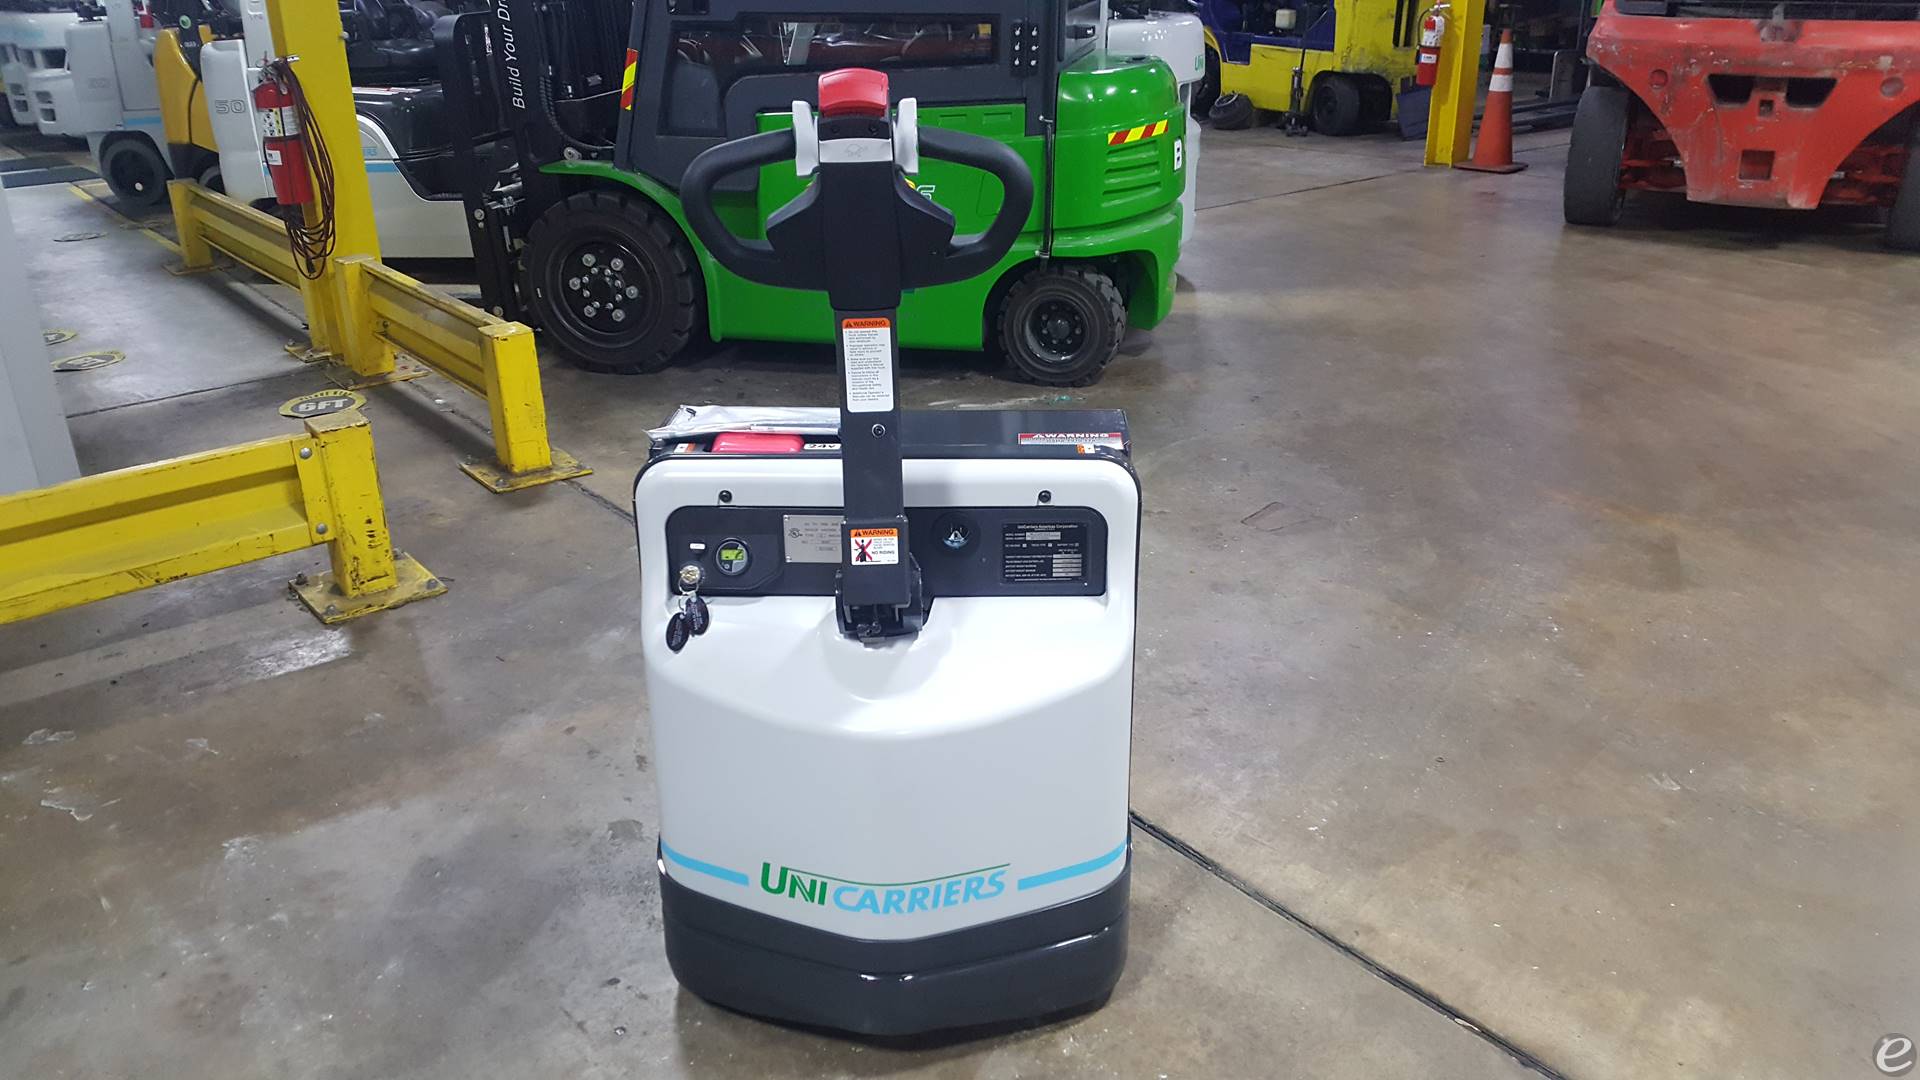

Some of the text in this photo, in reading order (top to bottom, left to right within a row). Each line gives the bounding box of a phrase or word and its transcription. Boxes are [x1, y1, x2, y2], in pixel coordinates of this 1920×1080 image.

[503, 24, 517, 61] Your
[508, 66, 525, 109] Build
[853, 319, 886, 328] WARNING
[298, 399, 348, 412] 6FT
